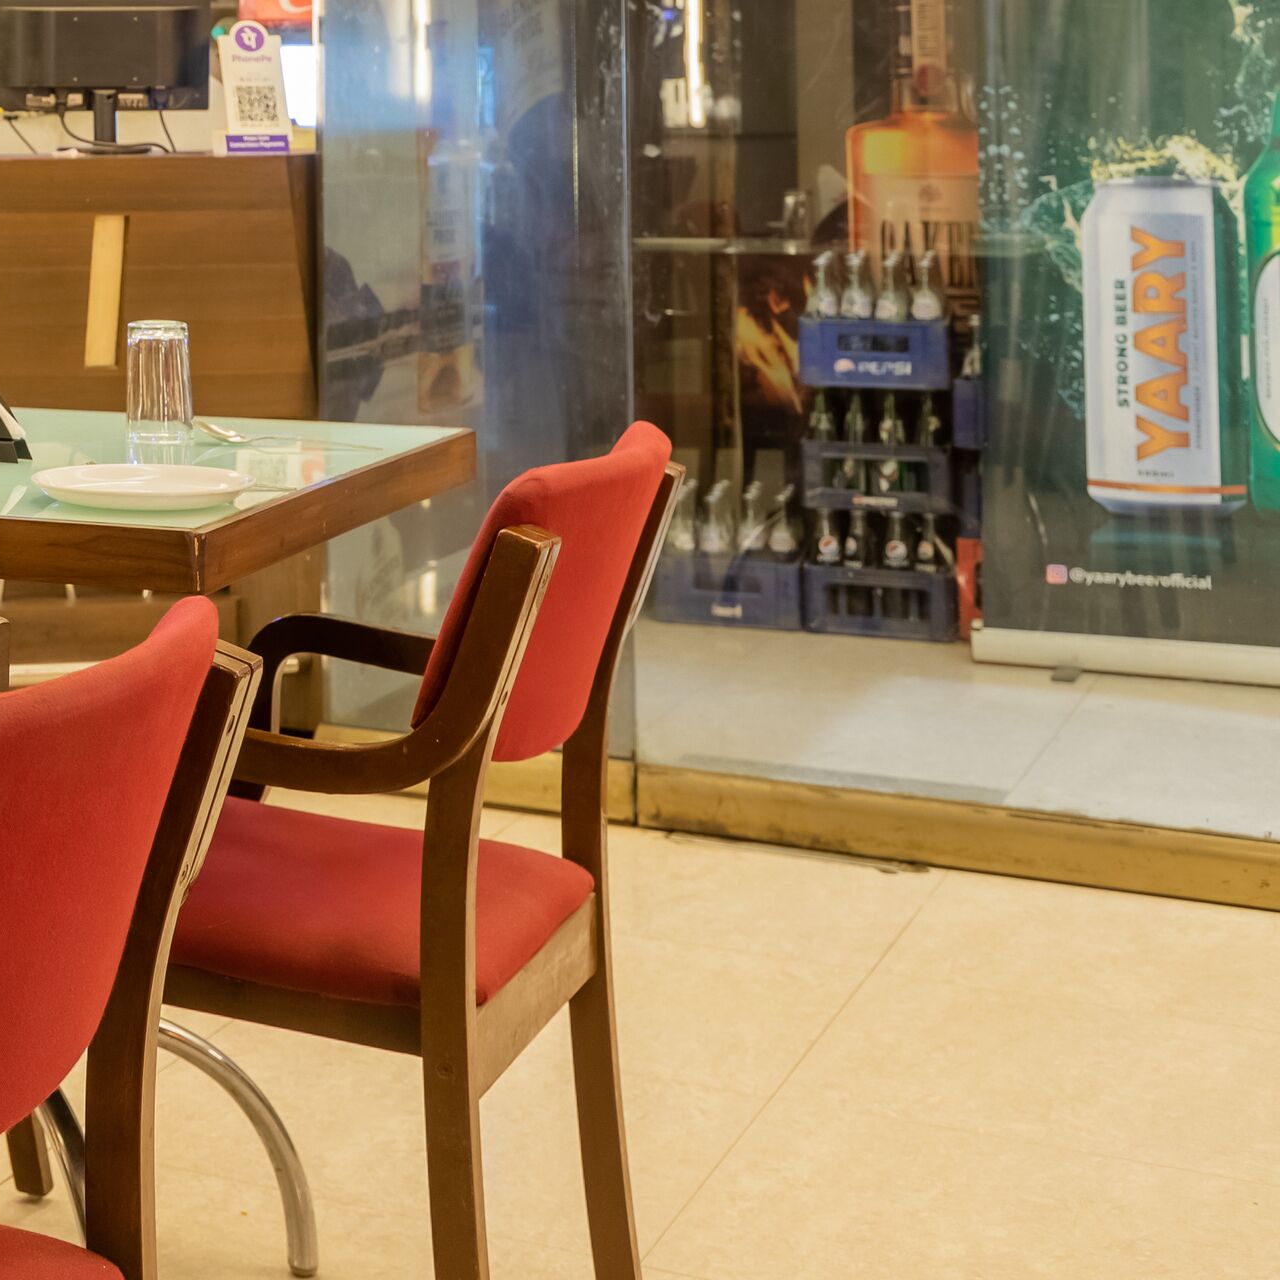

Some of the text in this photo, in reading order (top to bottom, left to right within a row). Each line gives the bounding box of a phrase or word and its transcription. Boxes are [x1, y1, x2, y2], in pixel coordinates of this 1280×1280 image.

[1113, 279, 1130, 408] STRONG BEER
[1131, 227, 1190, 461] YAARY
